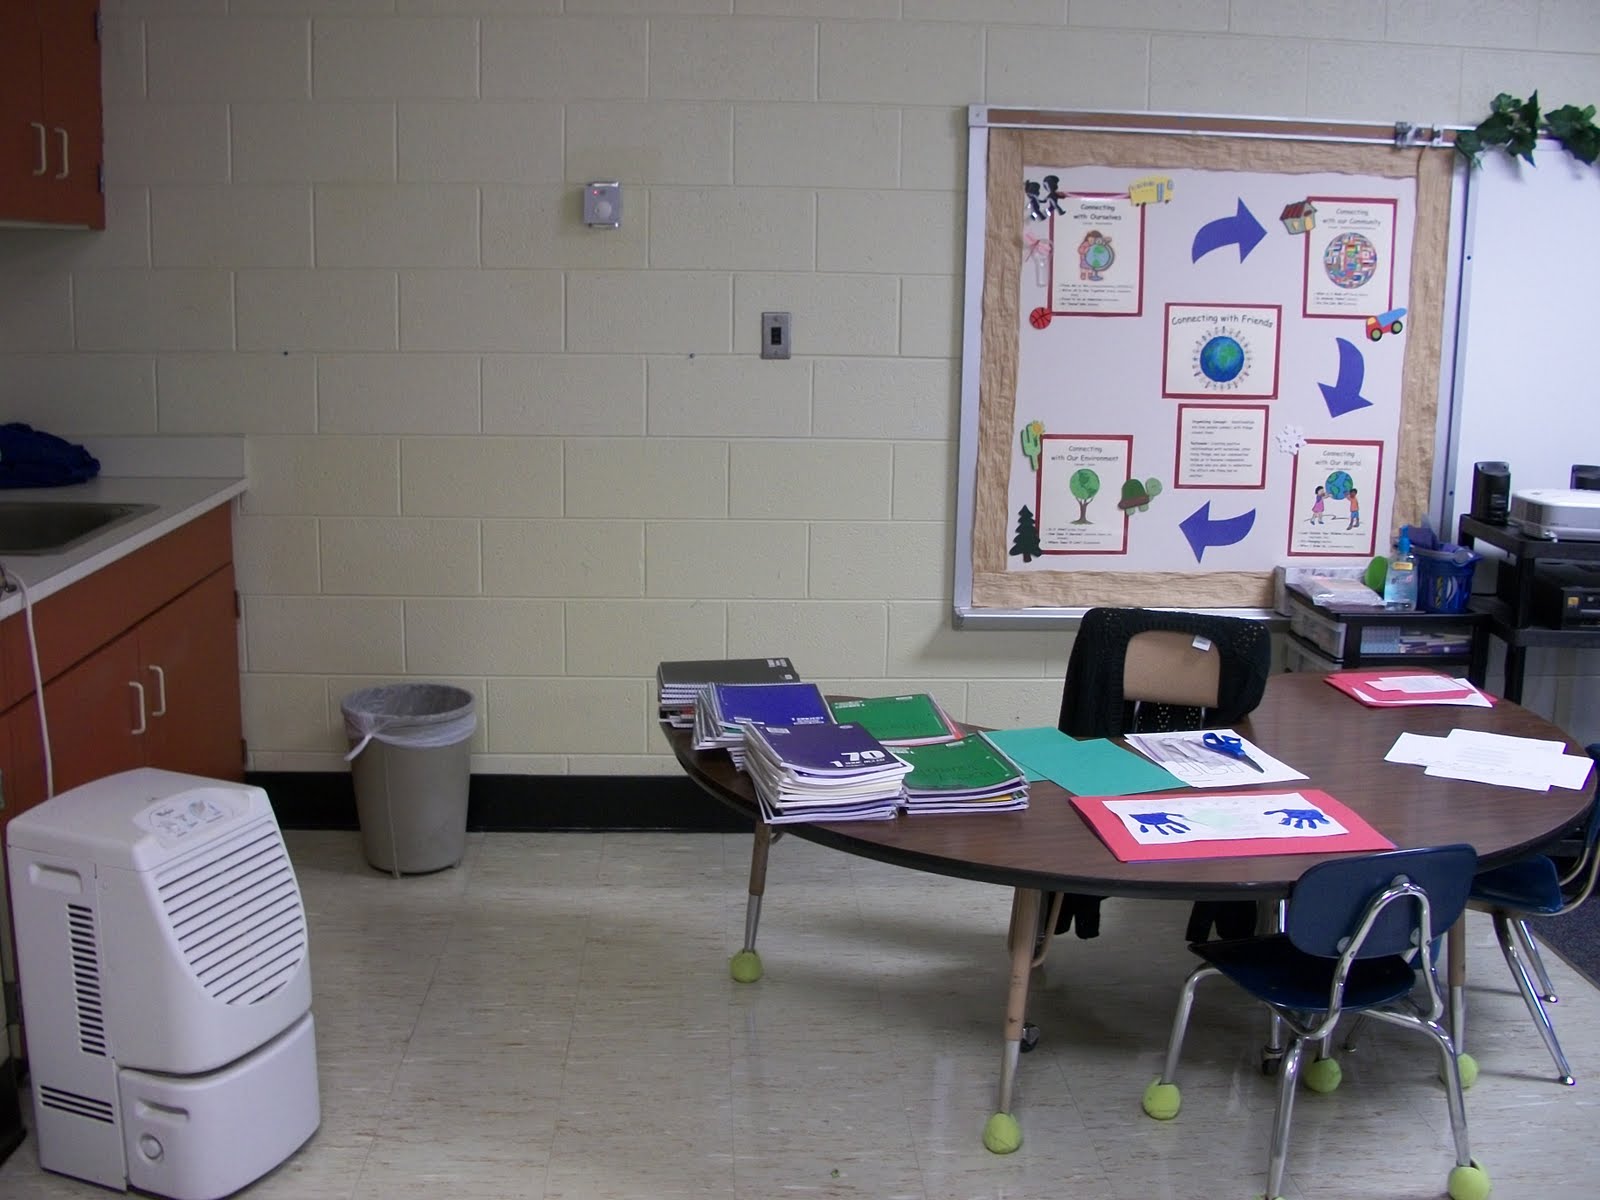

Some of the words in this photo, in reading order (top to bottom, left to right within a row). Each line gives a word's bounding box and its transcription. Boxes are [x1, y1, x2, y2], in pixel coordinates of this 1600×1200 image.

[1081, 204, 1115, 212] Connecting
[1172, 315, 1218, 325] Connecting
[1241, 315, 1273, 328] Friends
[841, 750, 886, 761] 70
